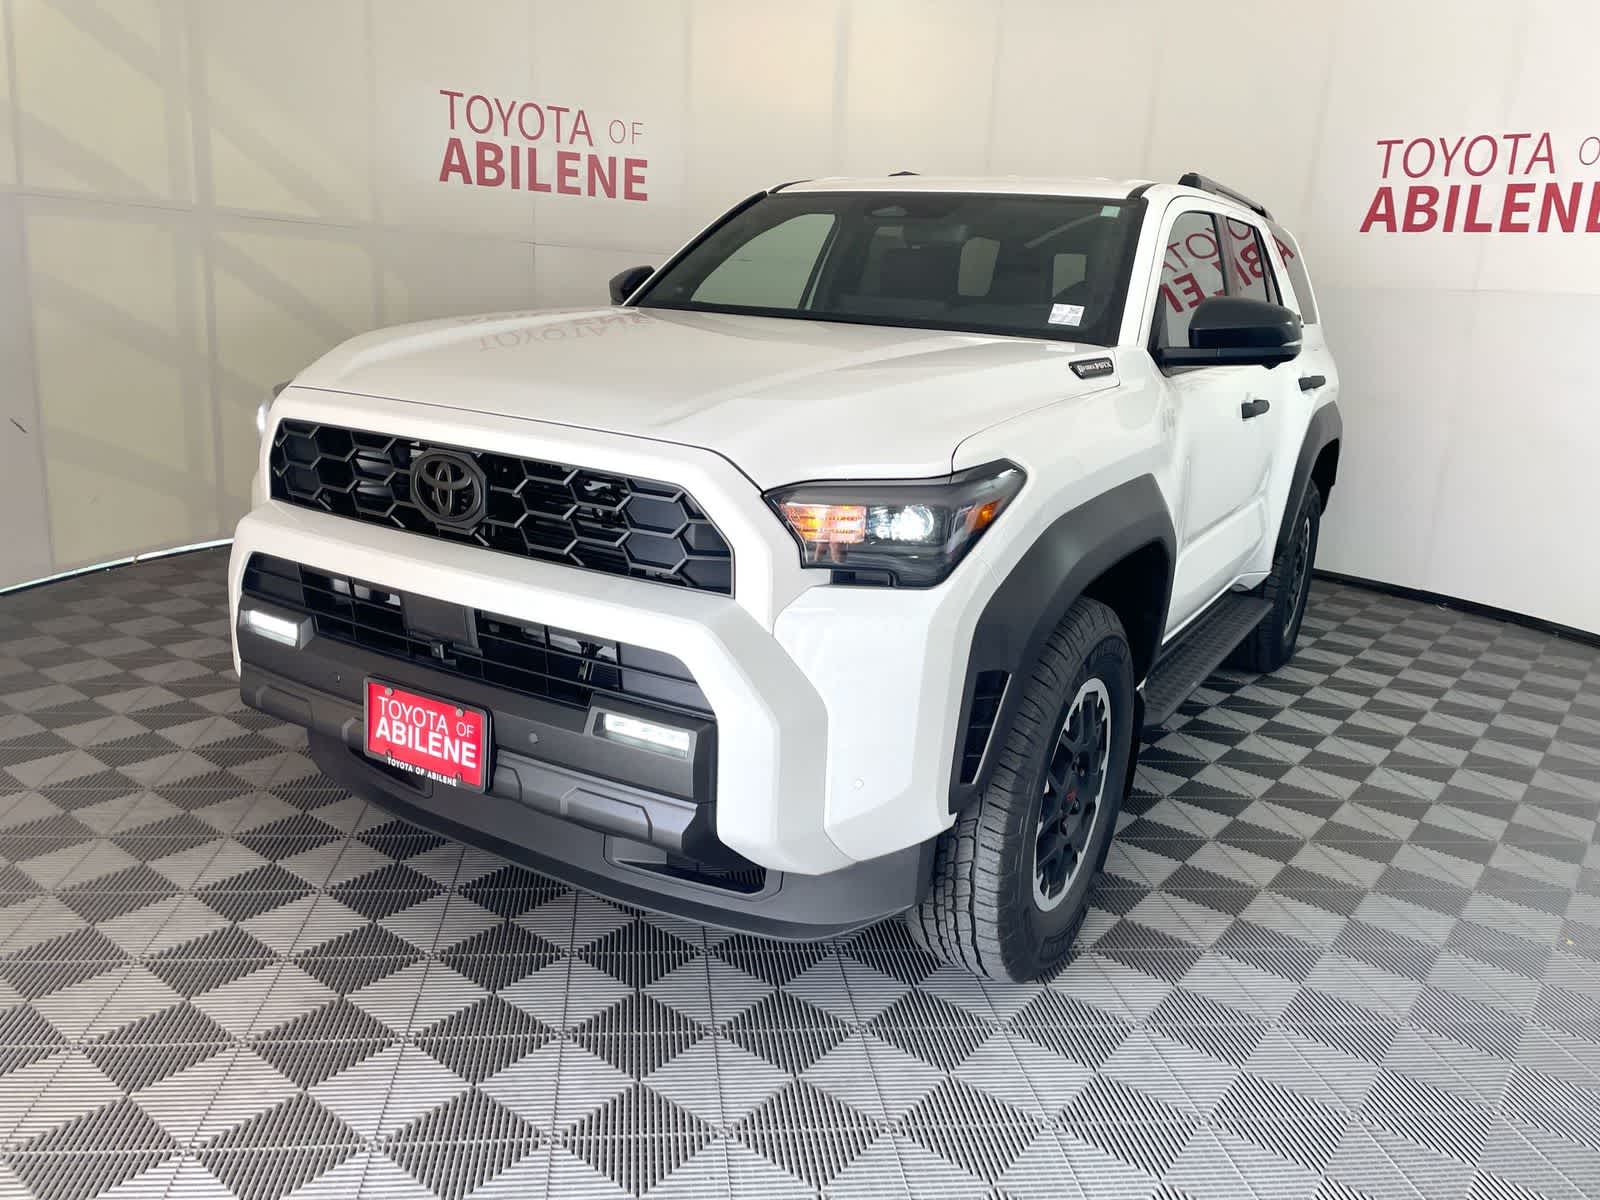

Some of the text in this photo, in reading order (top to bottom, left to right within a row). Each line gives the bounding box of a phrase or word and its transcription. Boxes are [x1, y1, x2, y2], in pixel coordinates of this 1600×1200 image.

[439, 89, 644, 147] TOYOTA OF
[438, 137, 649, 202] ABILENE
[1376, 132, 1600, 179] TOYOTA O
[377, 695, 475, 738] TOYOTA OF
[375, 716, 477, 769] ABILENE
[387, 757, 457, 787] TOYOTA OF ABILENE
